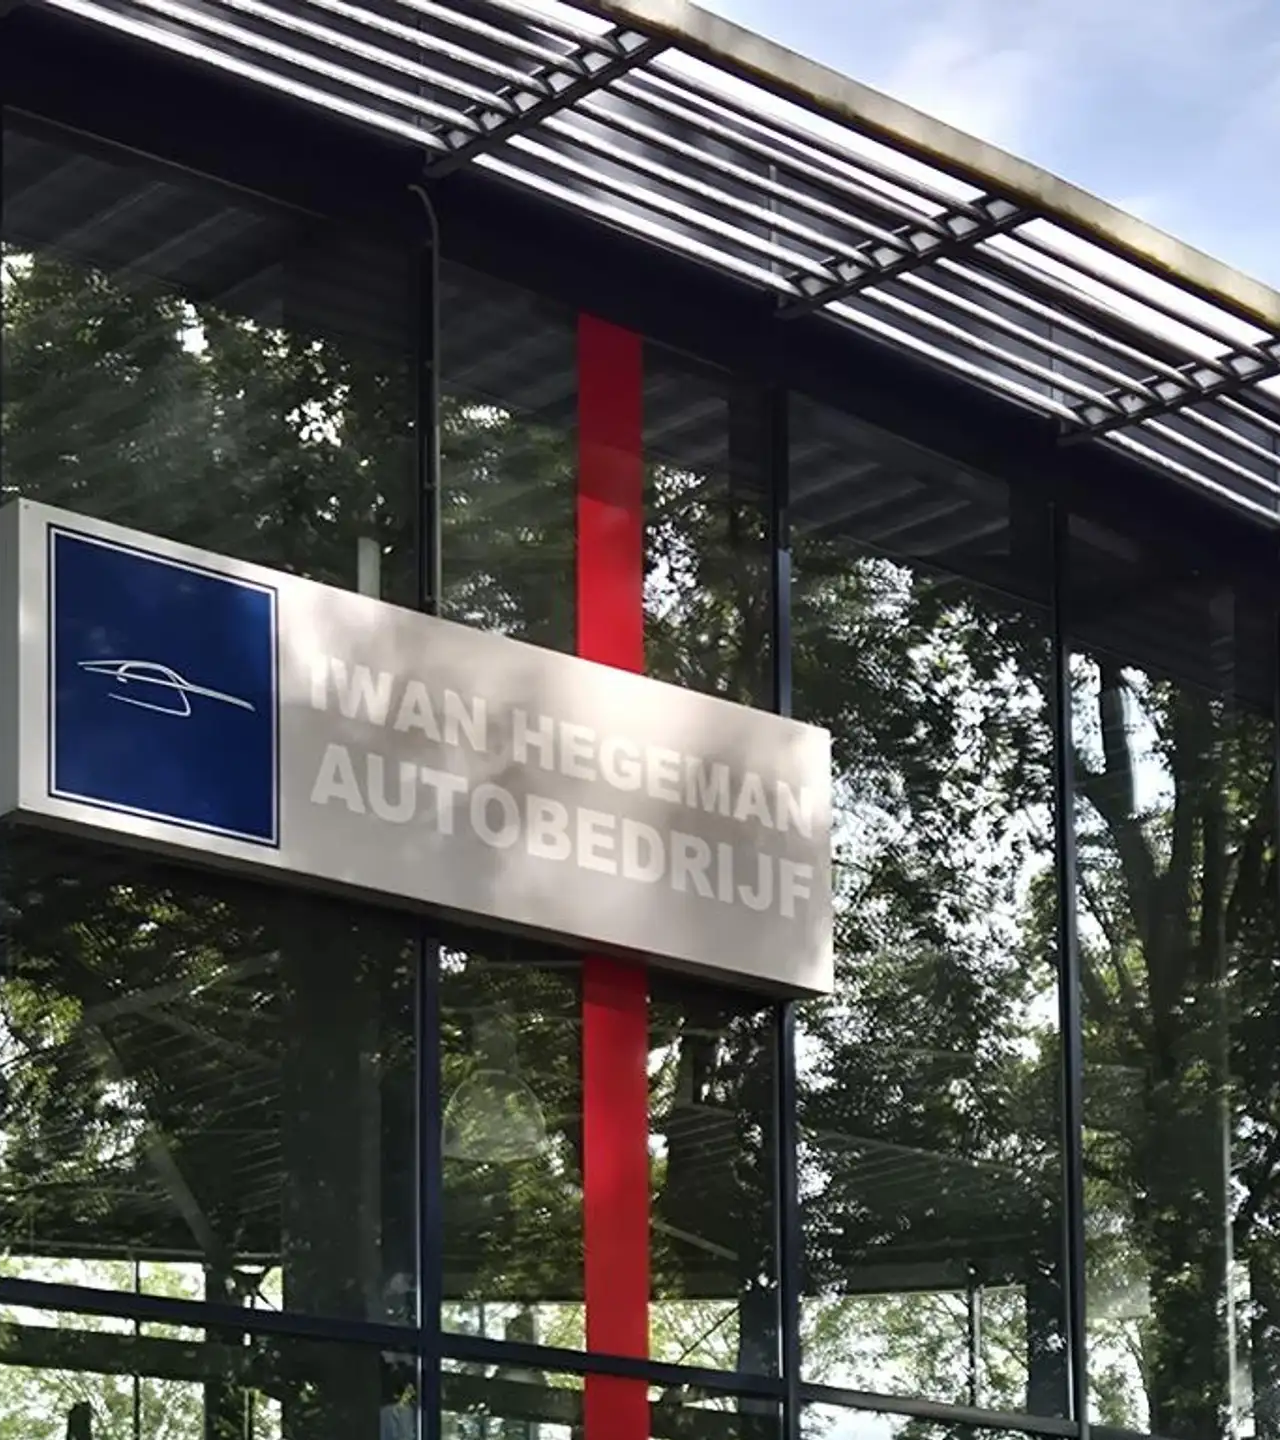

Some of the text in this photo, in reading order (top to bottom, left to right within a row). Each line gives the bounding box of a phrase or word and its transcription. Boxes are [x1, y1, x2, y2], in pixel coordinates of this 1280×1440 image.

[309, 742, 814, 919] AUTOBEDRIJF
[310, 653, 814, 839] IWAN HEGEMAN
